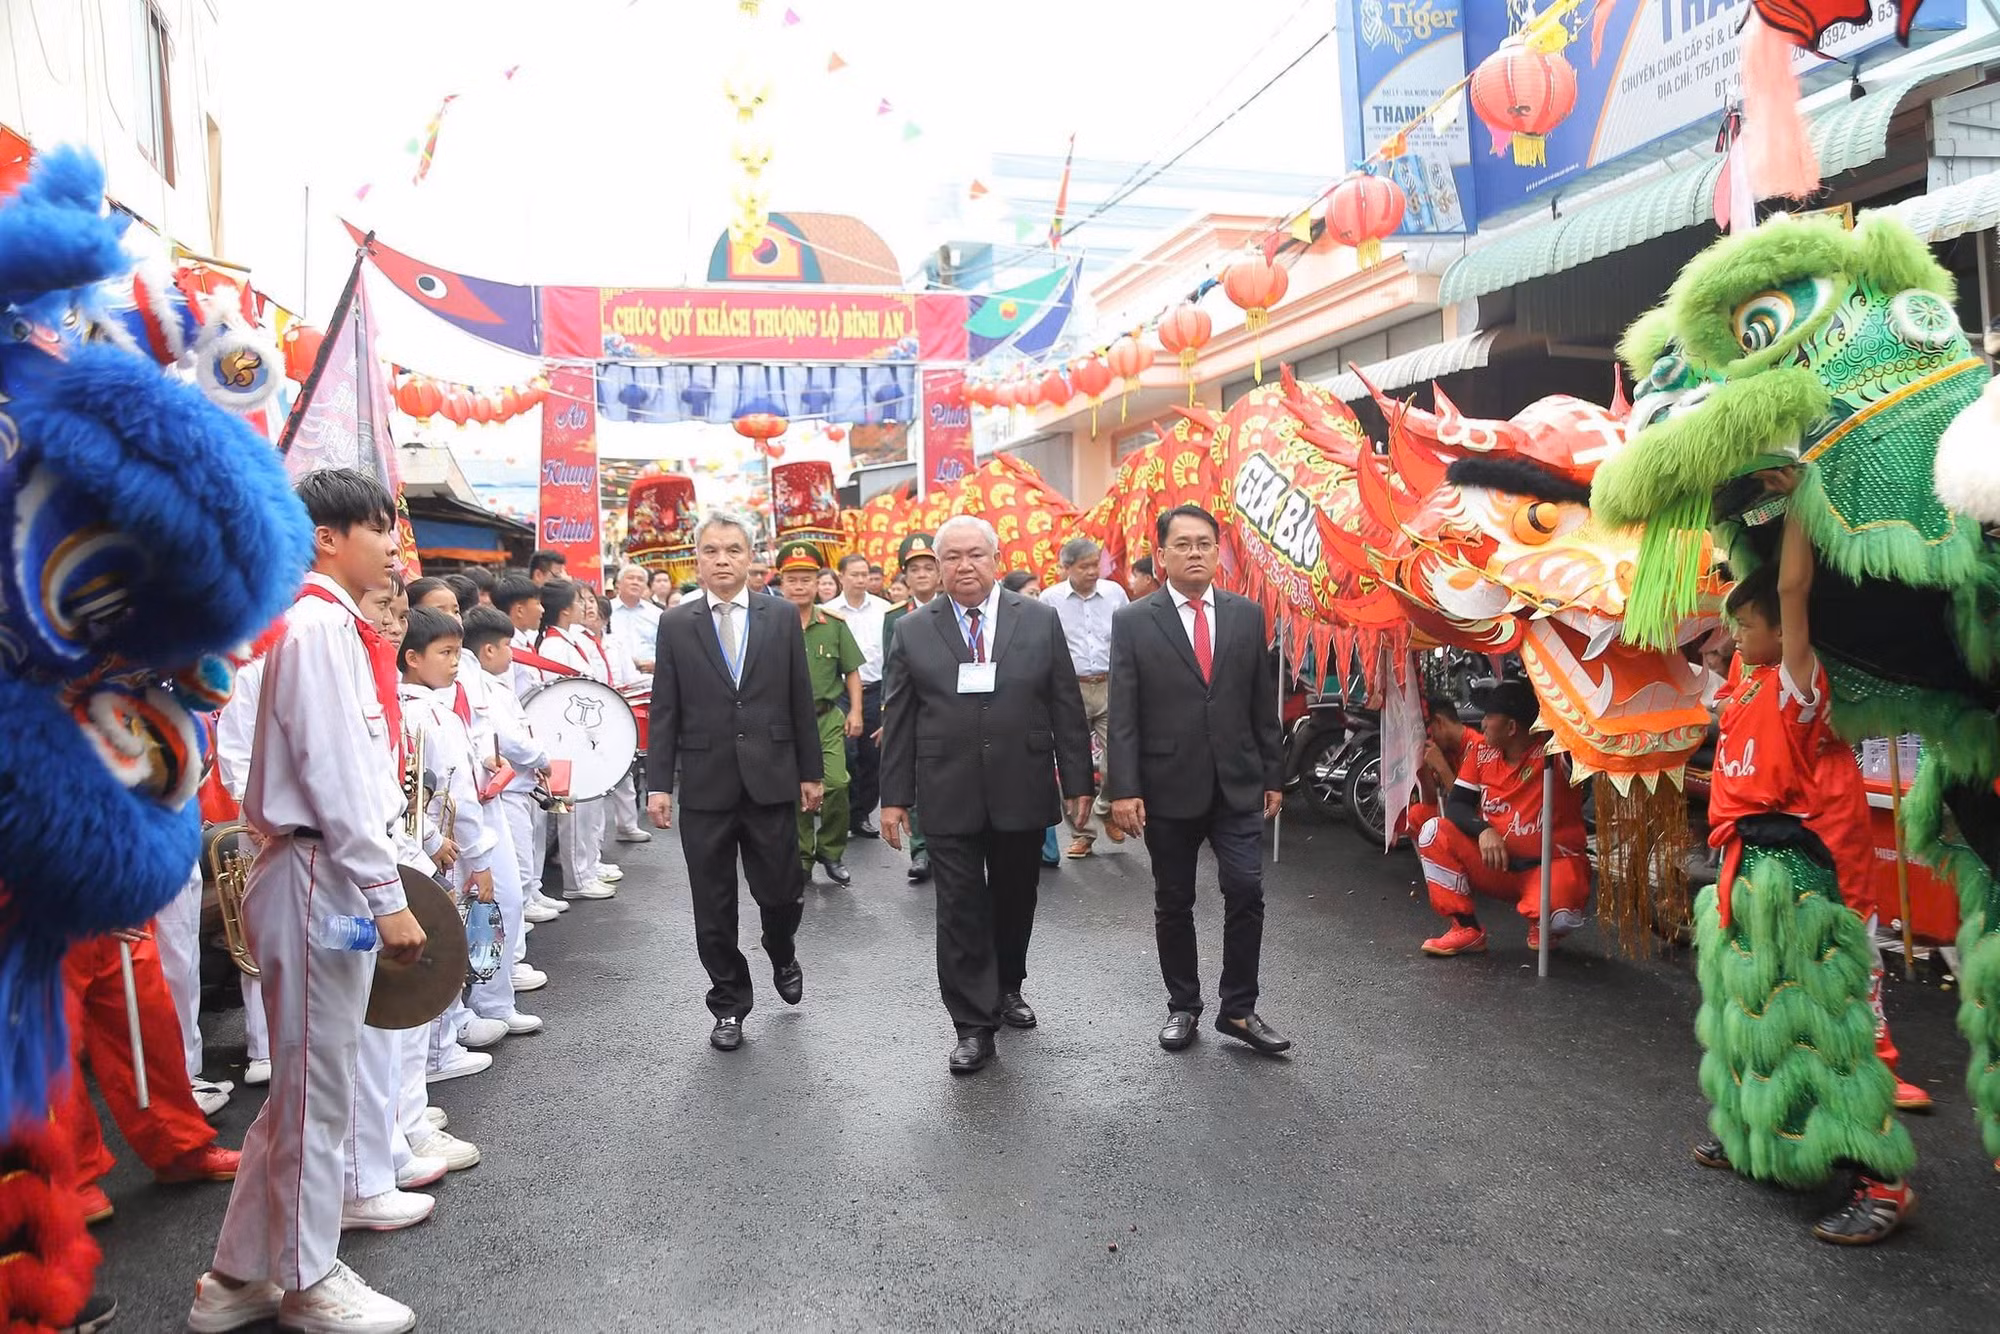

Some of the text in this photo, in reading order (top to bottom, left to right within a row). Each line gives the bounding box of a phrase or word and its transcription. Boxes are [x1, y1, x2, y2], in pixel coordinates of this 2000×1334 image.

[1388, 2, 1458, 39] Tiger
[1622, 63, 1656, 95] CHUYÊN
[1657, 50, 1682, 76] CUNG
[1684, 35, 1703, 62] CẤP
[1717, 28, 1725, 46] &
[1657, 79, 1673, 102] ĐỊA
[1695, 56, 1720, 81] 175/1
[613, 299, 905, 346] CHÚC QUÝ KHÁCH THƯỢNG LỘ BÌNH AN
